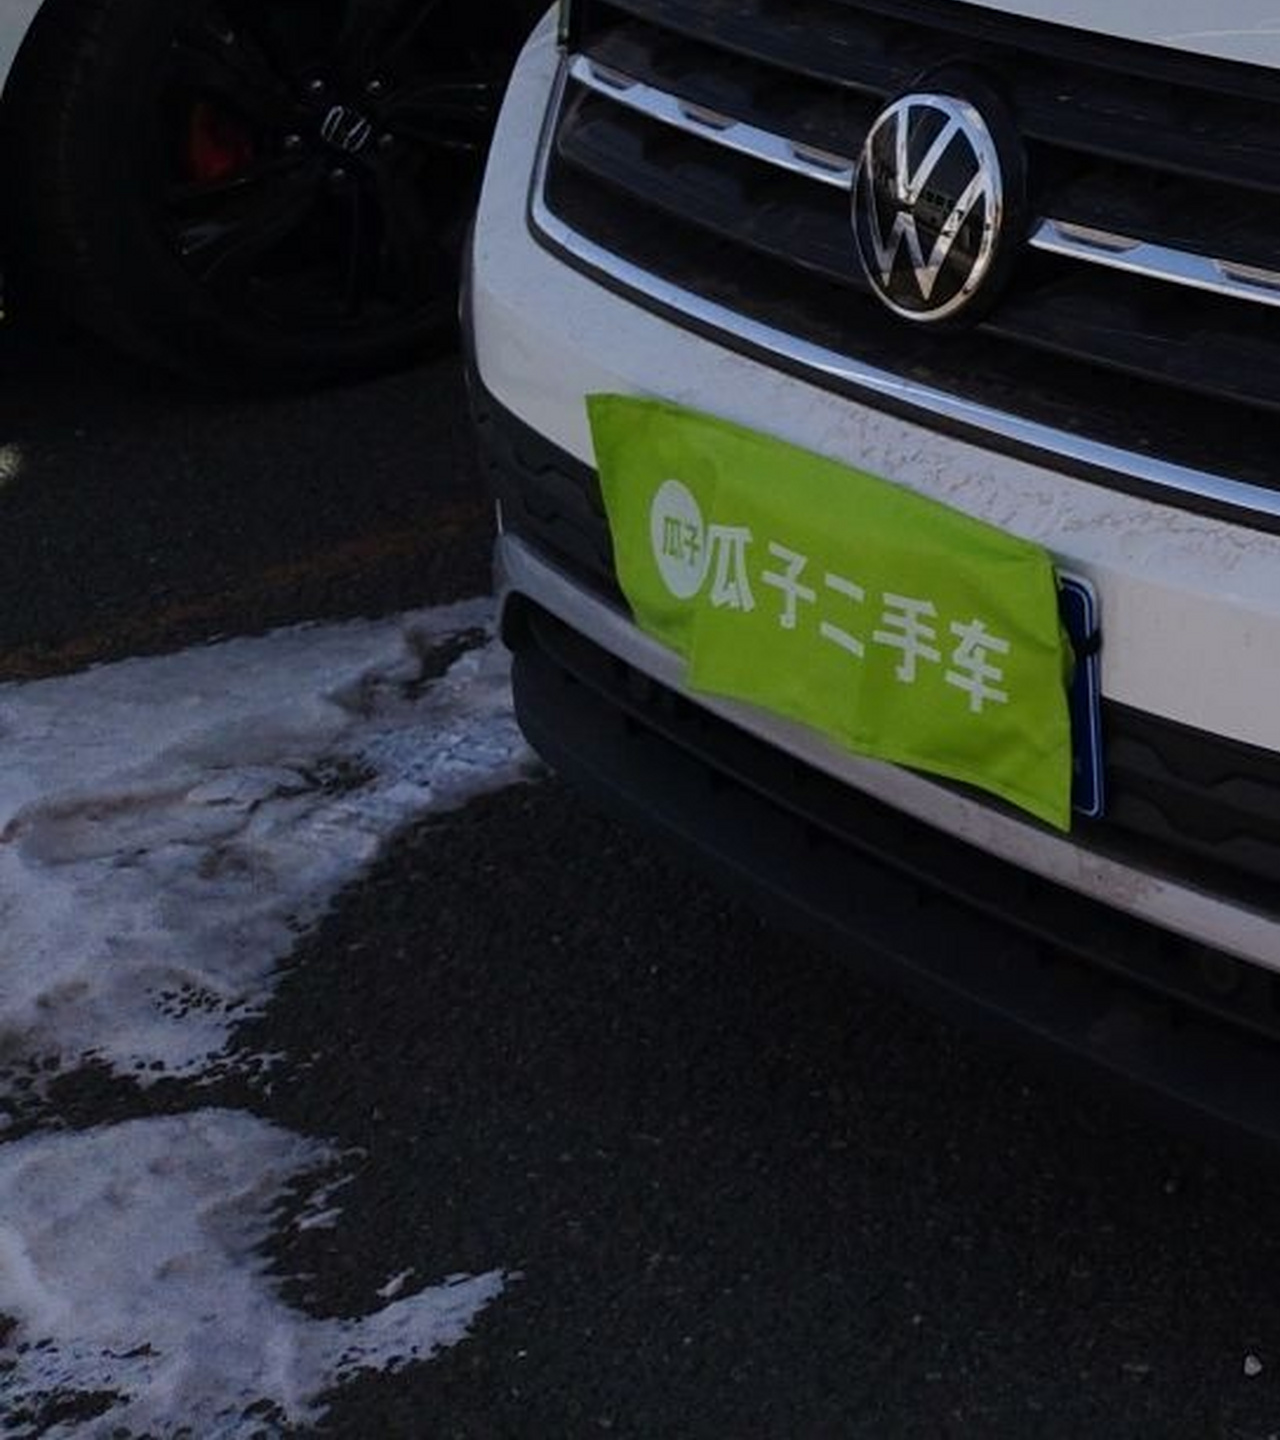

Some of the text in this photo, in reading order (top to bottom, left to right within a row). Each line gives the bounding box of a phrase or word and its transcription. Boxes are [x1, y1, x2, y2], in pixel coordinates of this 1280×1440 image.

[706, 523, 1010, 713] 瓜子二手车
